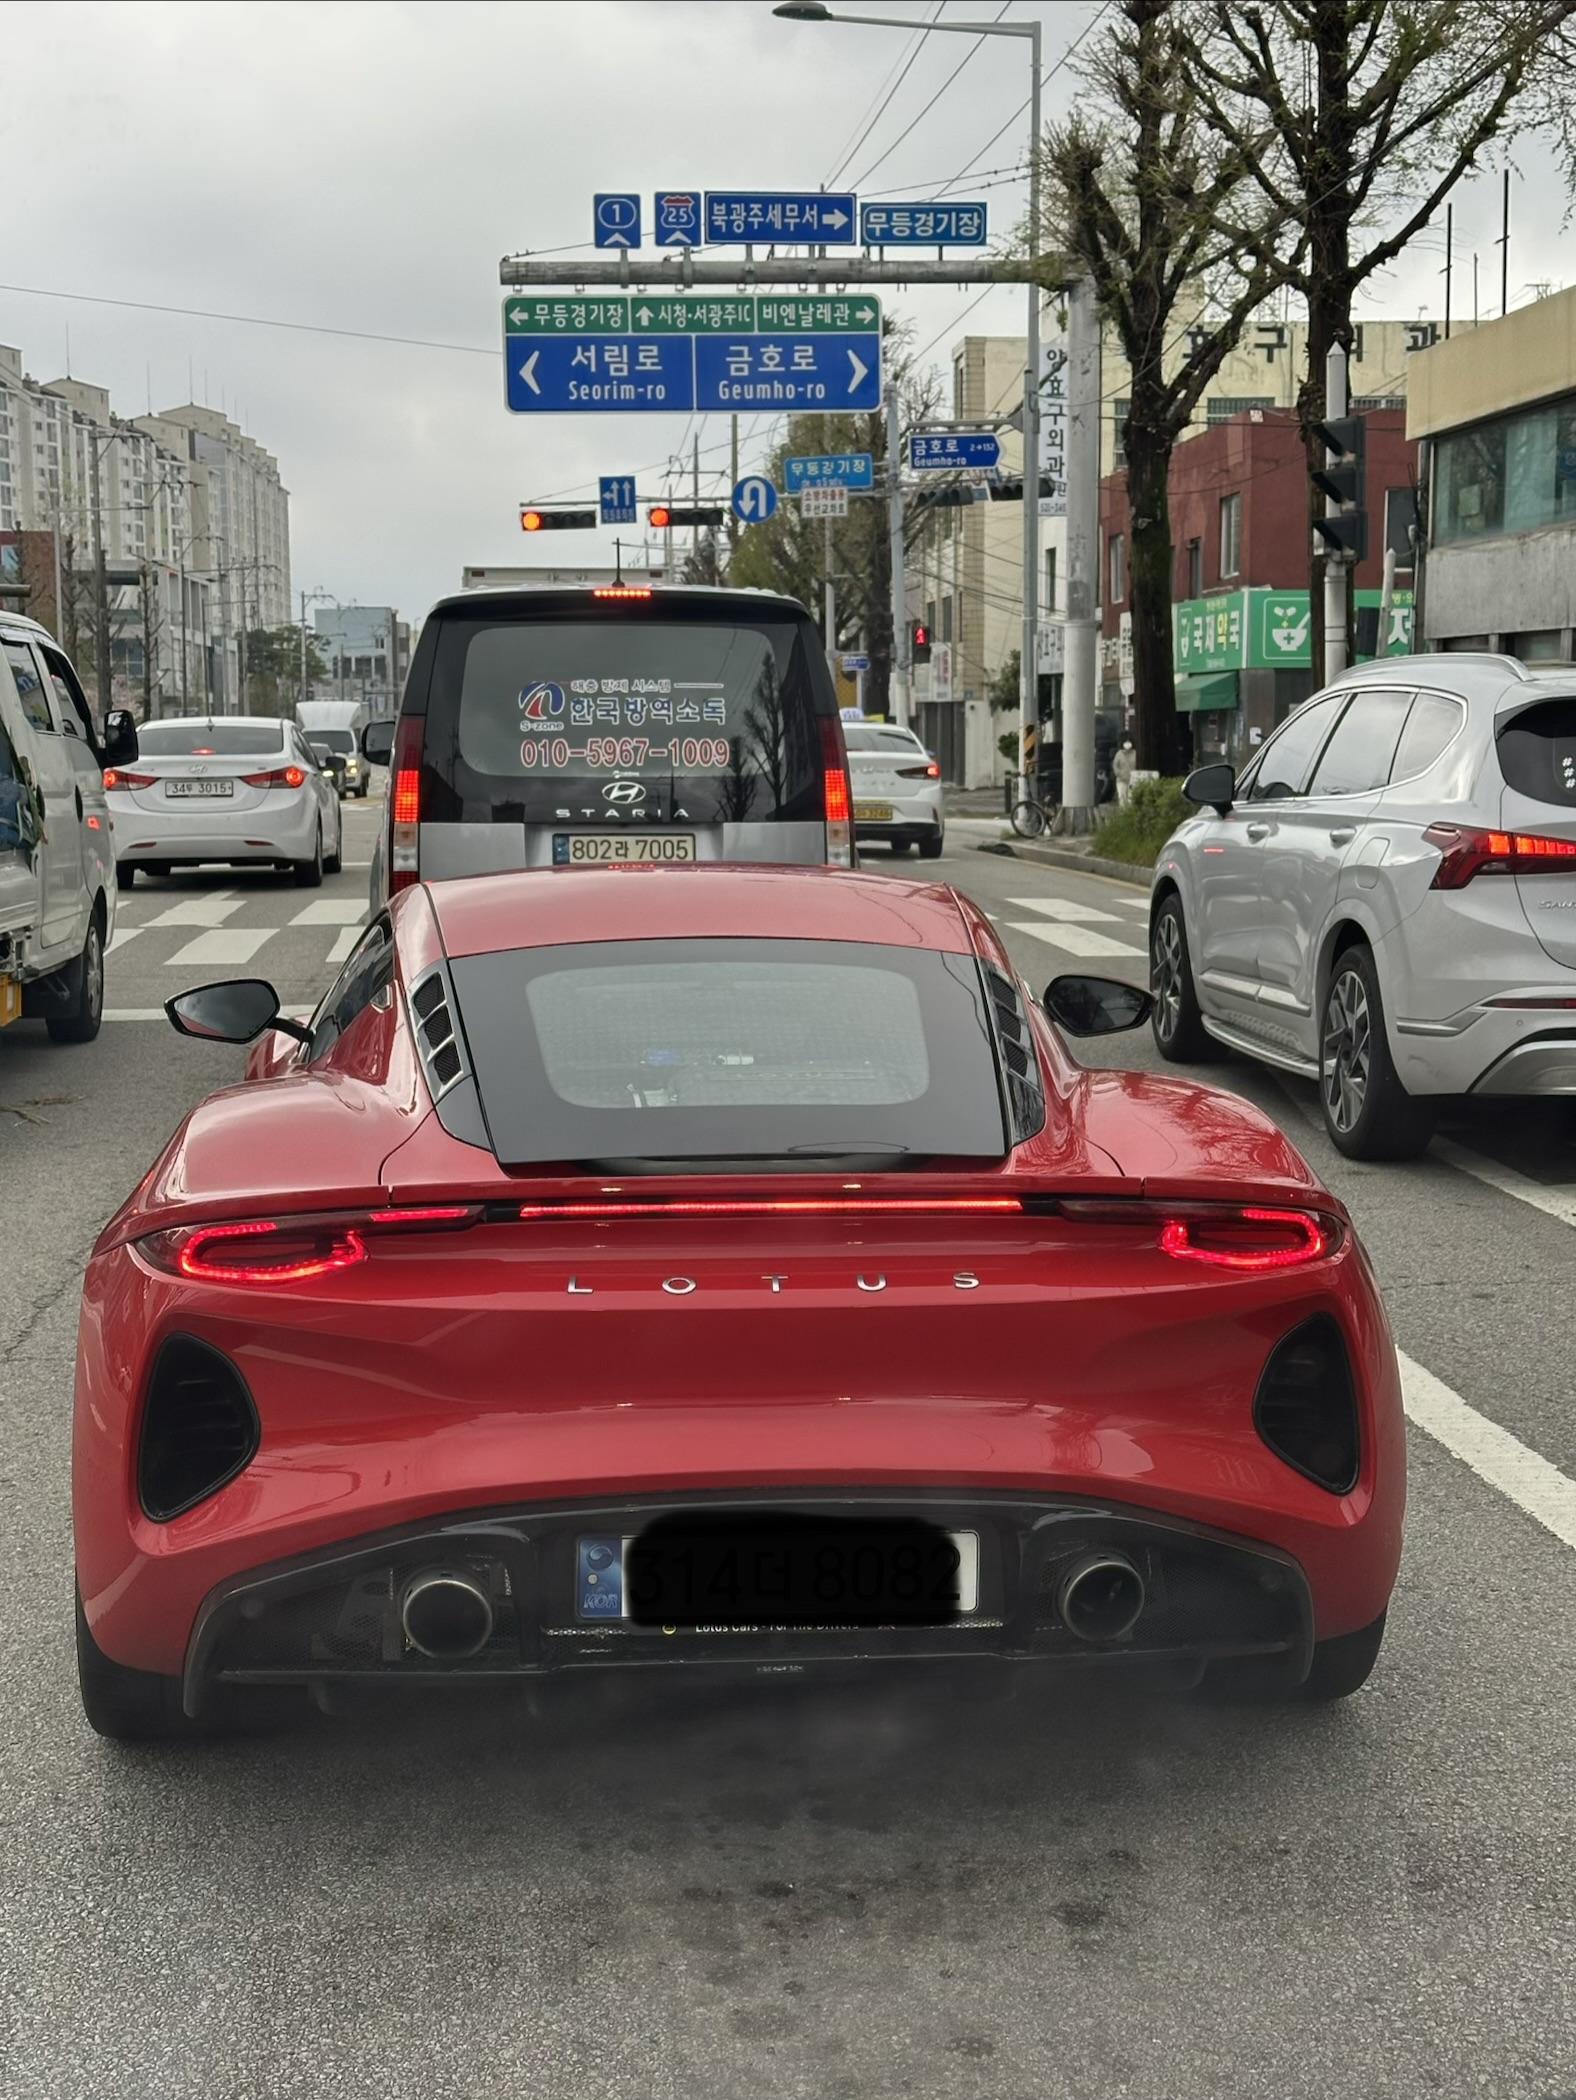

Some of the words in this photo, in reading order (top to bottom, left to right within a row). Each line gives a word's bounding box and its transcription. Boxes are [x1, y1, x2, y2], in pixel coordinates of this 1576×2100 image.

[610, 203, 622, 223] 1
[668, 207, 688, 223] 25
[711, 202, 818, 233] 북광주세무서
[866, 211, 982, 237] 무등경기장
[534, 304, 624, 329] 무등경기장
[762, 303, 850, 327] 비엔날레관
[570, 343, 664, 376] 서림로
[725, 343, 818, 375] 금호로
[568, 381, 666, 400] Seorim-ro
[718, 380, 826, 400] Geumho-ro
[913, 439, 960, 457] 금호로
[791, 460, 865, 476] 무등경기장
[913, 456, 967, 467] Geumho-ro
[631, 679, 671, 693] 시스템
[571, 698, 725, 726] 한국방역소독
[521, 737, 729, 768] 010-5967-1009
[199, 783, 226, 793] 3015
[556, 809, 689, 818] STARIA
[572, 839, 629, 860] 802라
[636, 839, 688, 860] 7005
[567, 1272, 980, 1294] LOTUS
